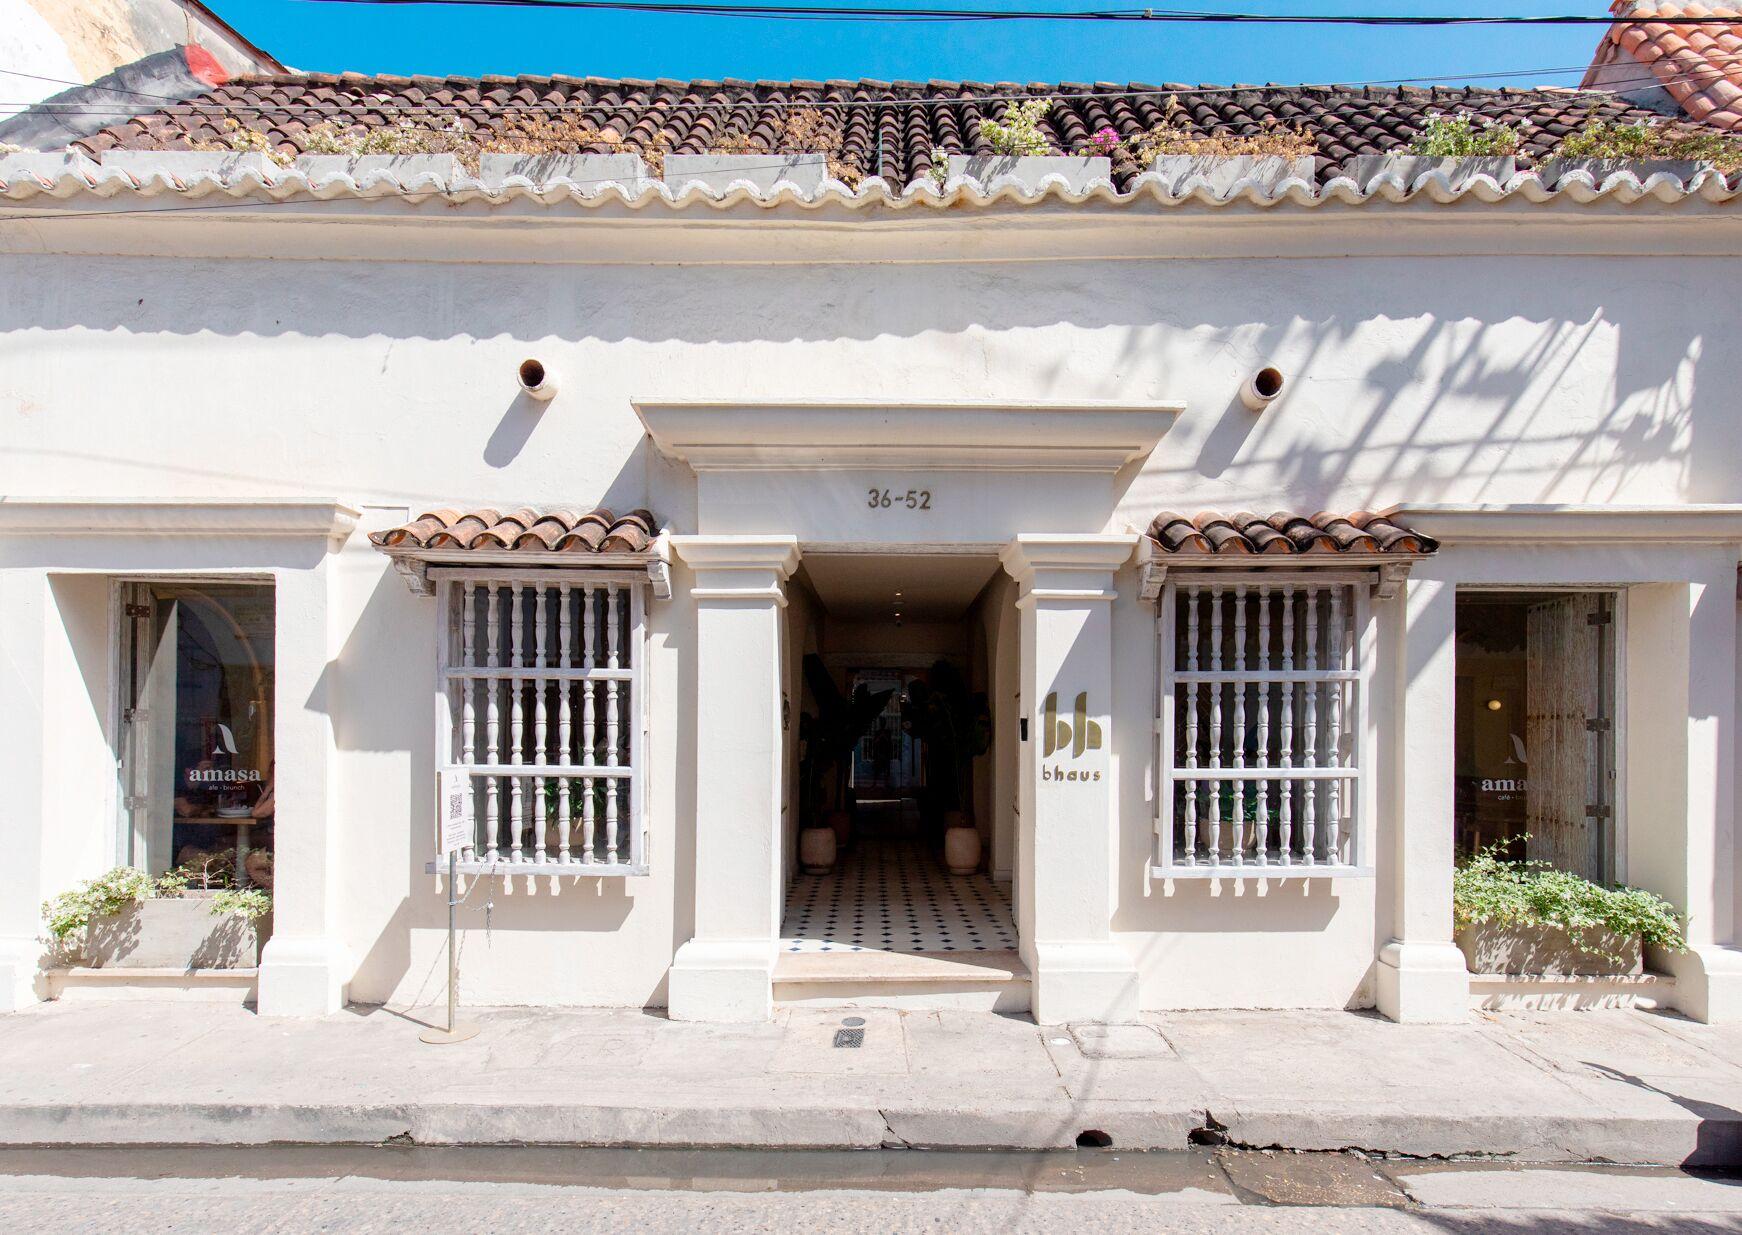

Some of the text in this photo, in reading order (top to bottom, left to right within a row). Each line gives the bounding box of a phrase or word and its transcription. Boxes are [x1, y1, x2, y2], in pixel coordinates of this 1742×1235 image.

[868, 488, 931, 510] 36-52
[189, 769, 262, 782] amasa
[1042, 764, 1102, 781] bhaus
